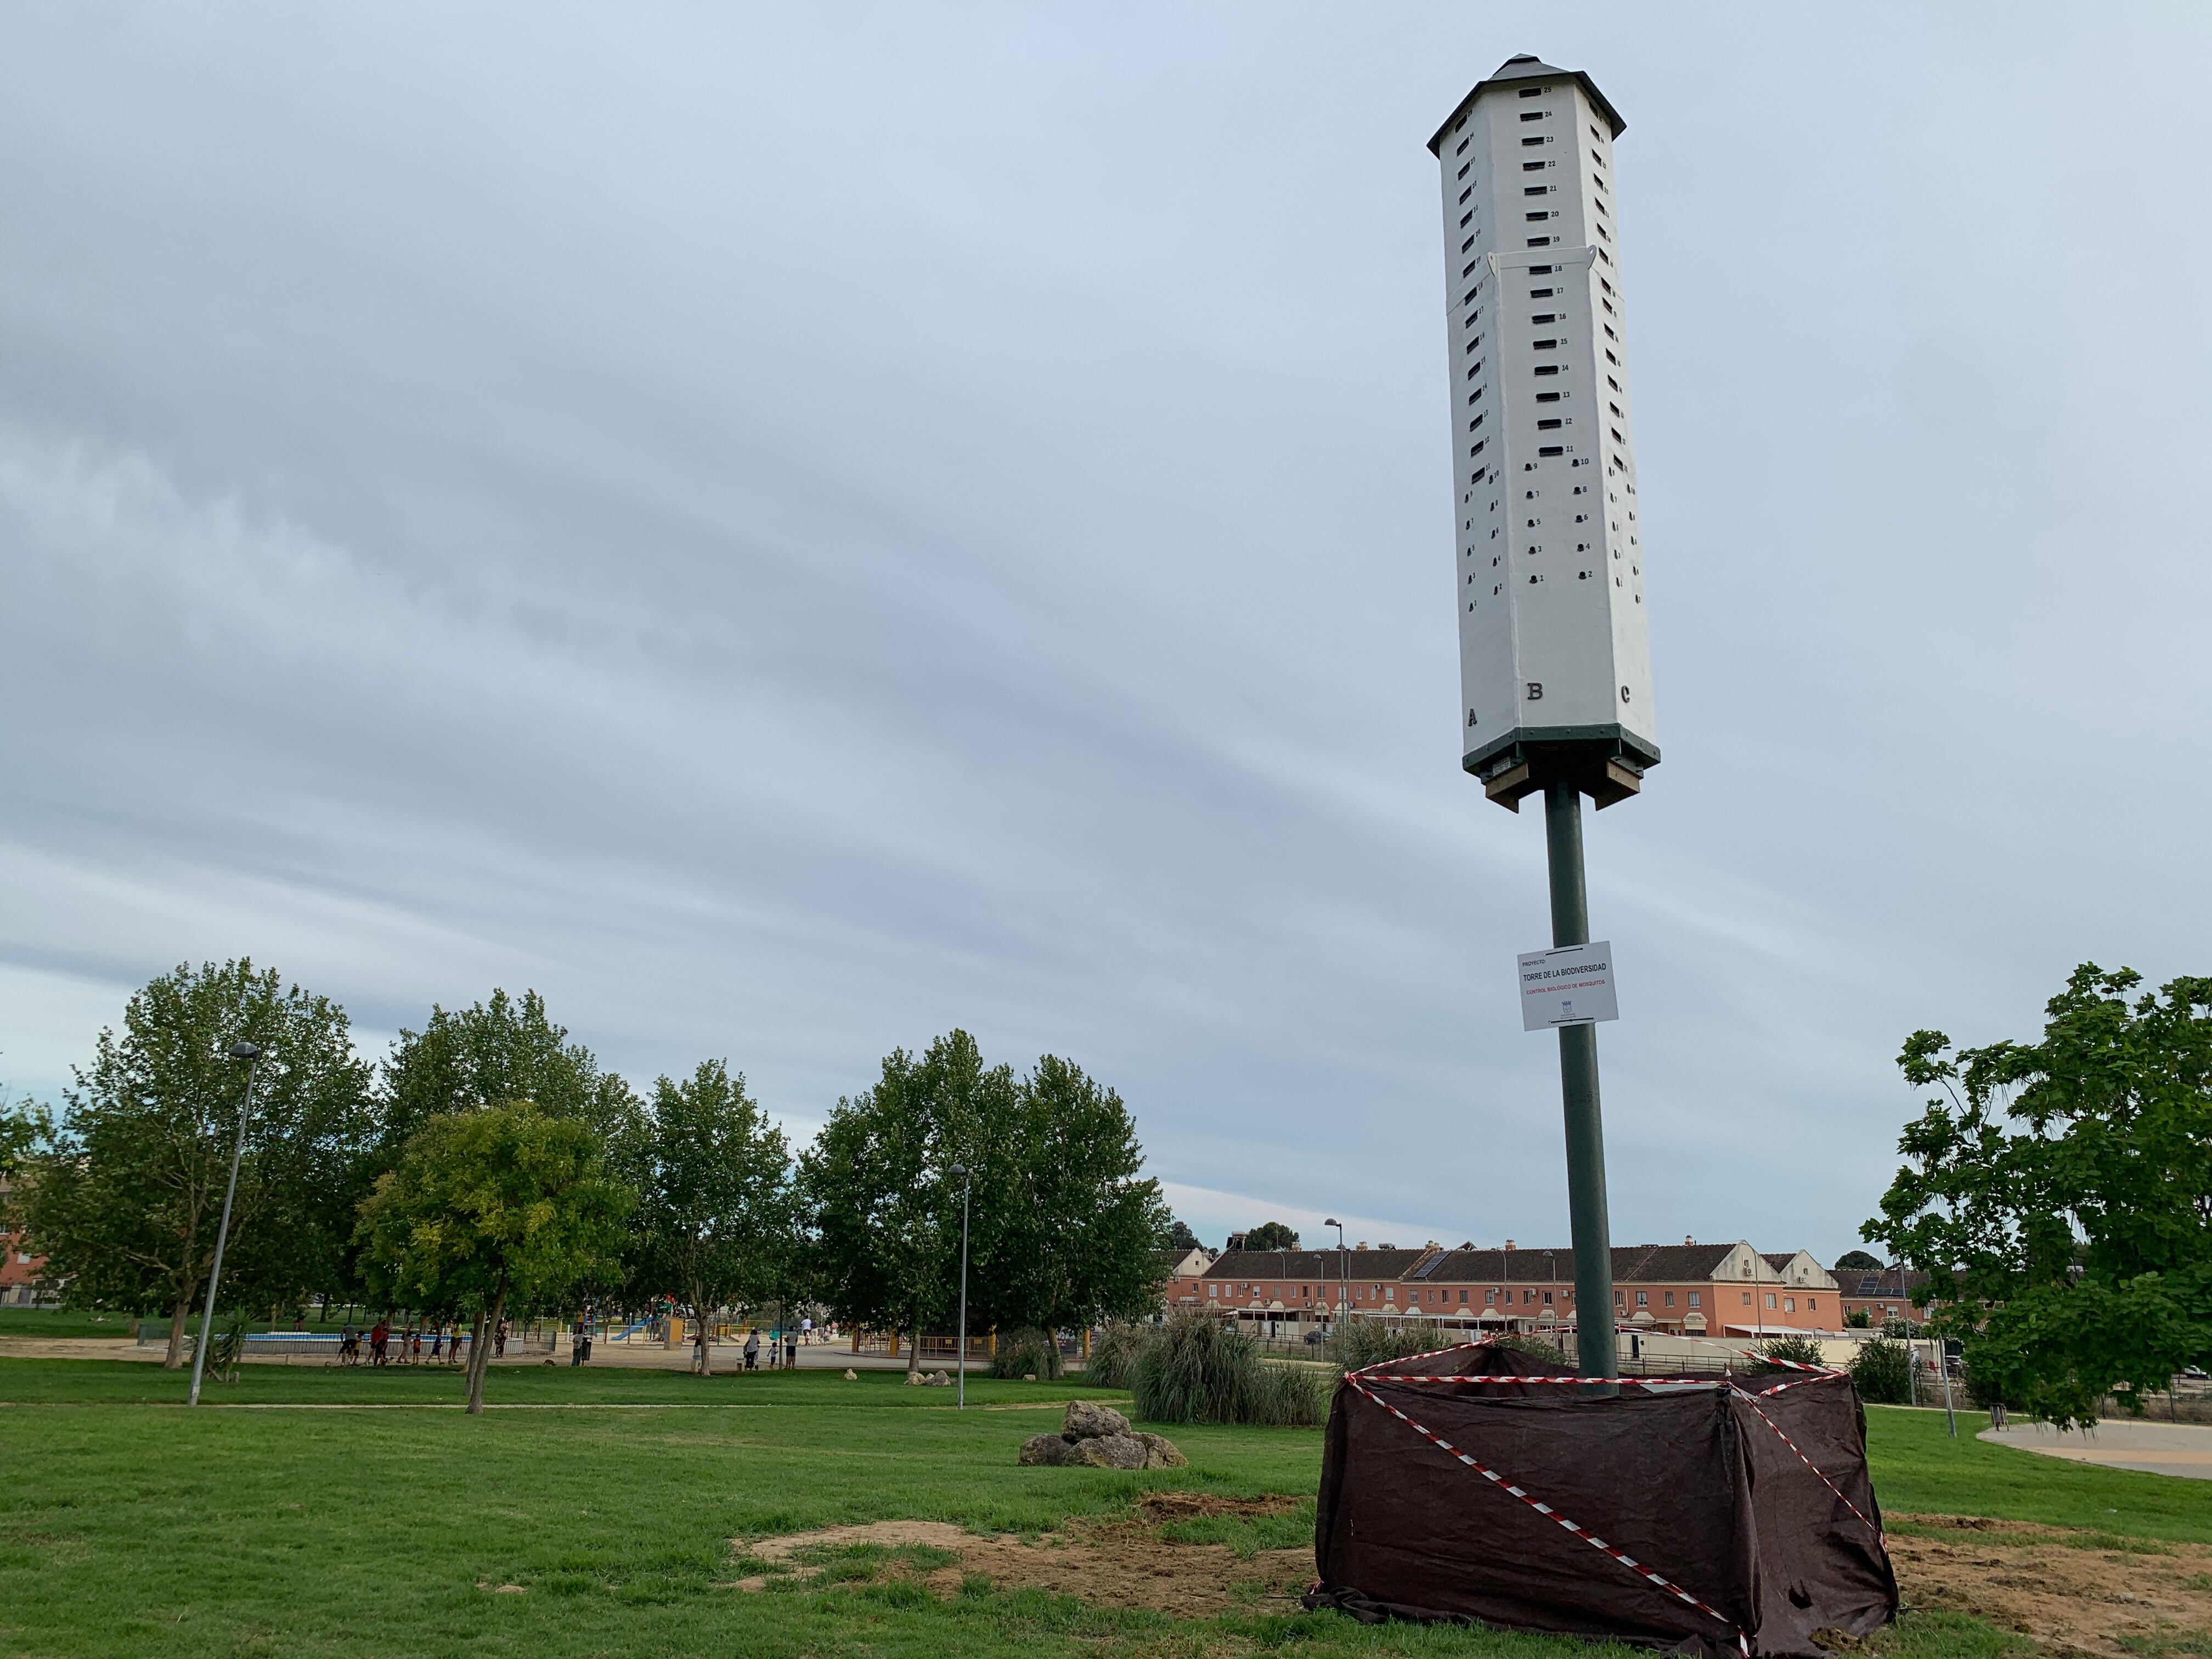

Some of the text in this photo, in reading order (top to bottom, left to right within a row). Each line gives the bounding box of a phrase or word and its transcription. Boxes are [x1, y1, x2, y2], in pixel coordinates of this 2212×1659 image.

[1486, 462, 1490, 471] 11
[1494, 470, 1499, 479] 10
[1527, 682, 1543, 700] B
[1621, 685, 1630, 703] C
[1468, 708, 1477, 727] A
[1523, 973, 1542, 981] TORRE
[1561, 963, 1606, 976] BIODIVERSIDAD
[1578, 979, 1605, 988] MOSQUITOS
